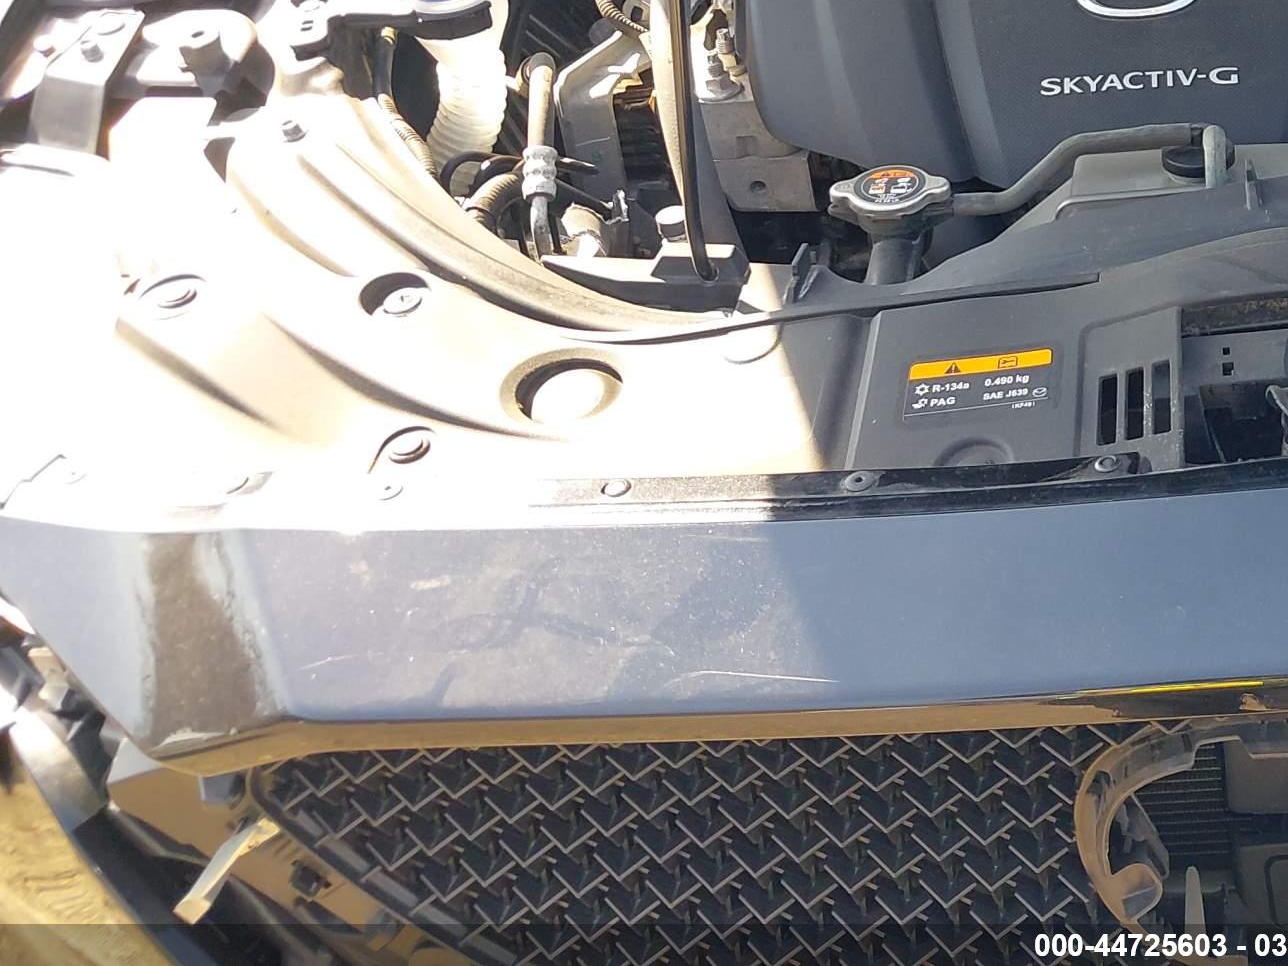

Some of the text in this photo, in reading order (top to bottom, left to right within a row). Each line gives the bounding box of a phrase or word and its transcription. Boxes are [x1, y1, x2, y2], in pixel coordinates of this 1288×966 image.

[1040, 67, 1240, 96] SKYACTIV-G
[932, 374, 1030, 393] R-134a 0.490 kg
[930, 396, 956, 407] PAG
[983, 390, 1004, 401] SAE
